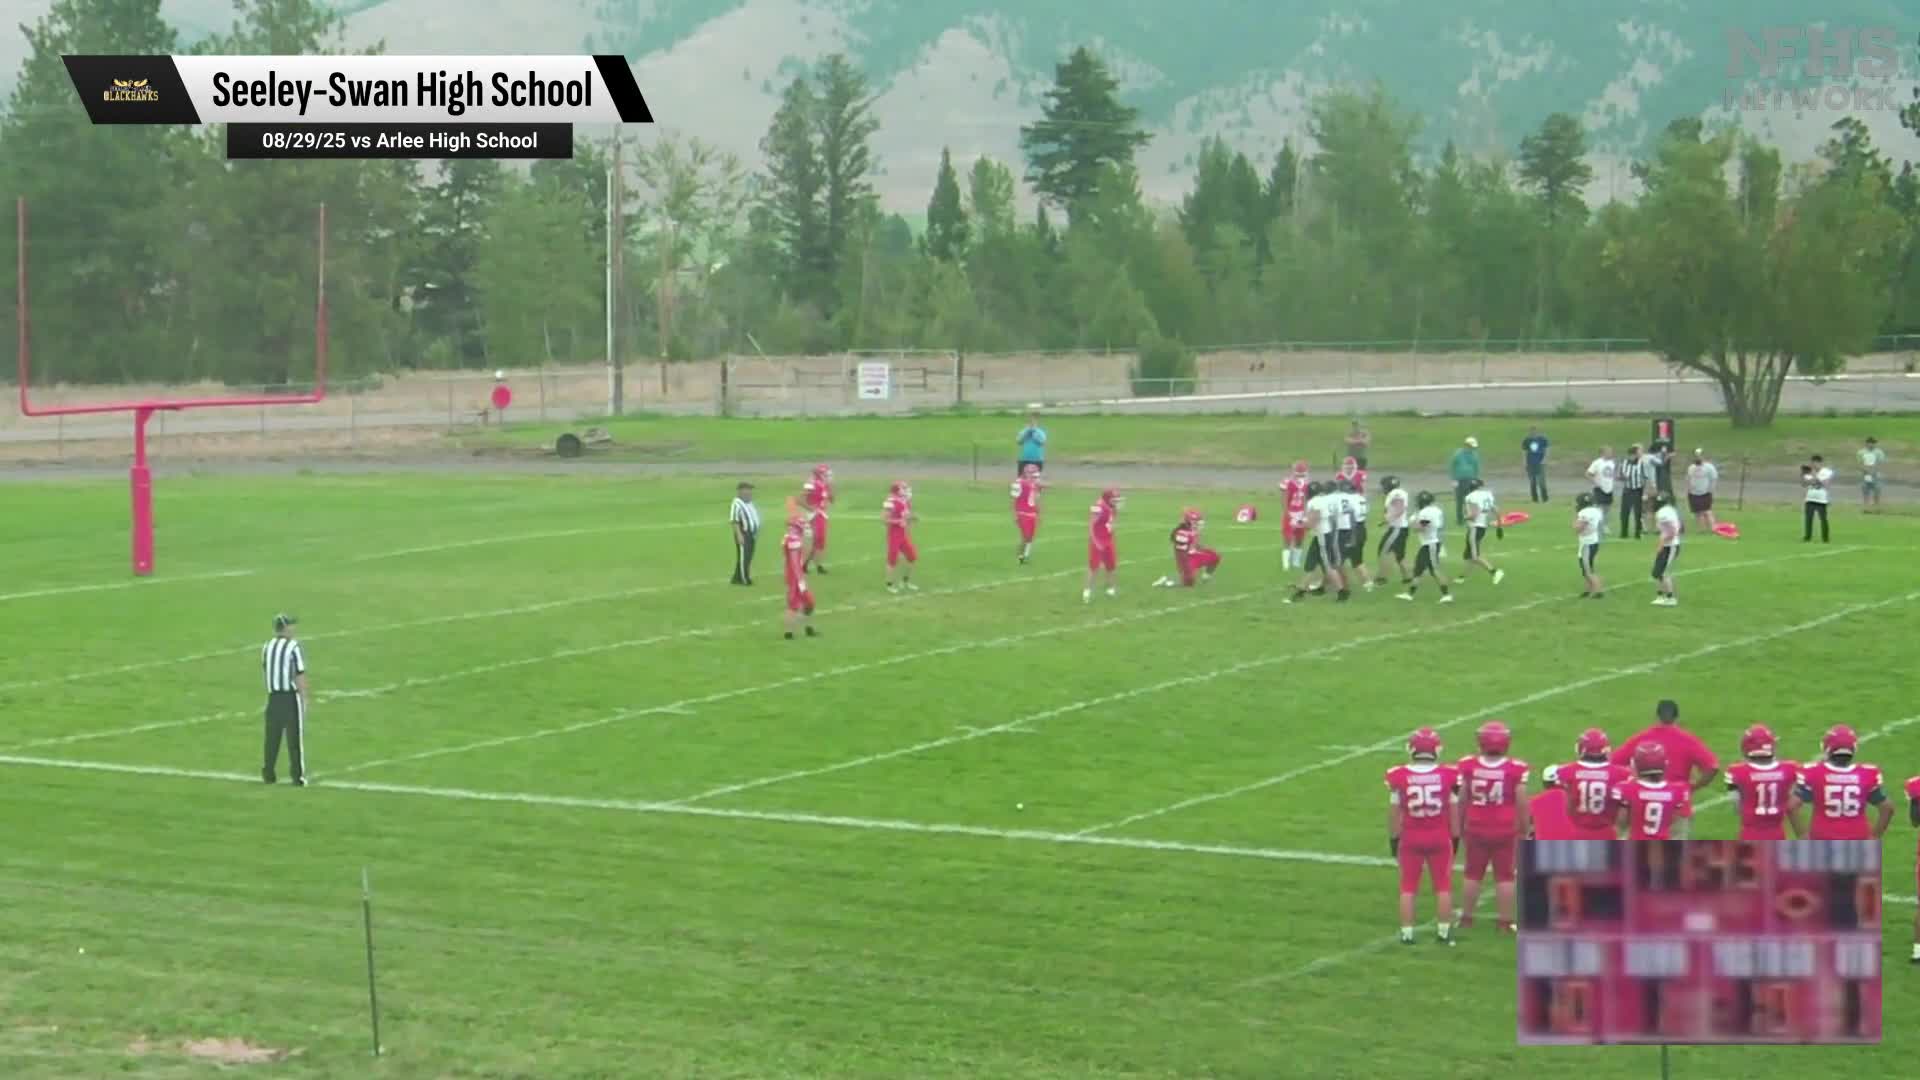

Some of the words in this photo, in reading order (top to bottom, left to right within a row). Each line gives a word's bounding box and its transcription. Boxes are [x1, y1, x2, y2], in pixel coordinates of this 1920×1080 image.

[1407, 784, 1442, 818] 25
[1472, 779, 1504, 806] 54
[1577, 780, 1607, 814] 18
[1755, 782, 1779, 816] 11
[1824, 784, 1861, 818] 56
[1643, 801, 1663, 836] 9
